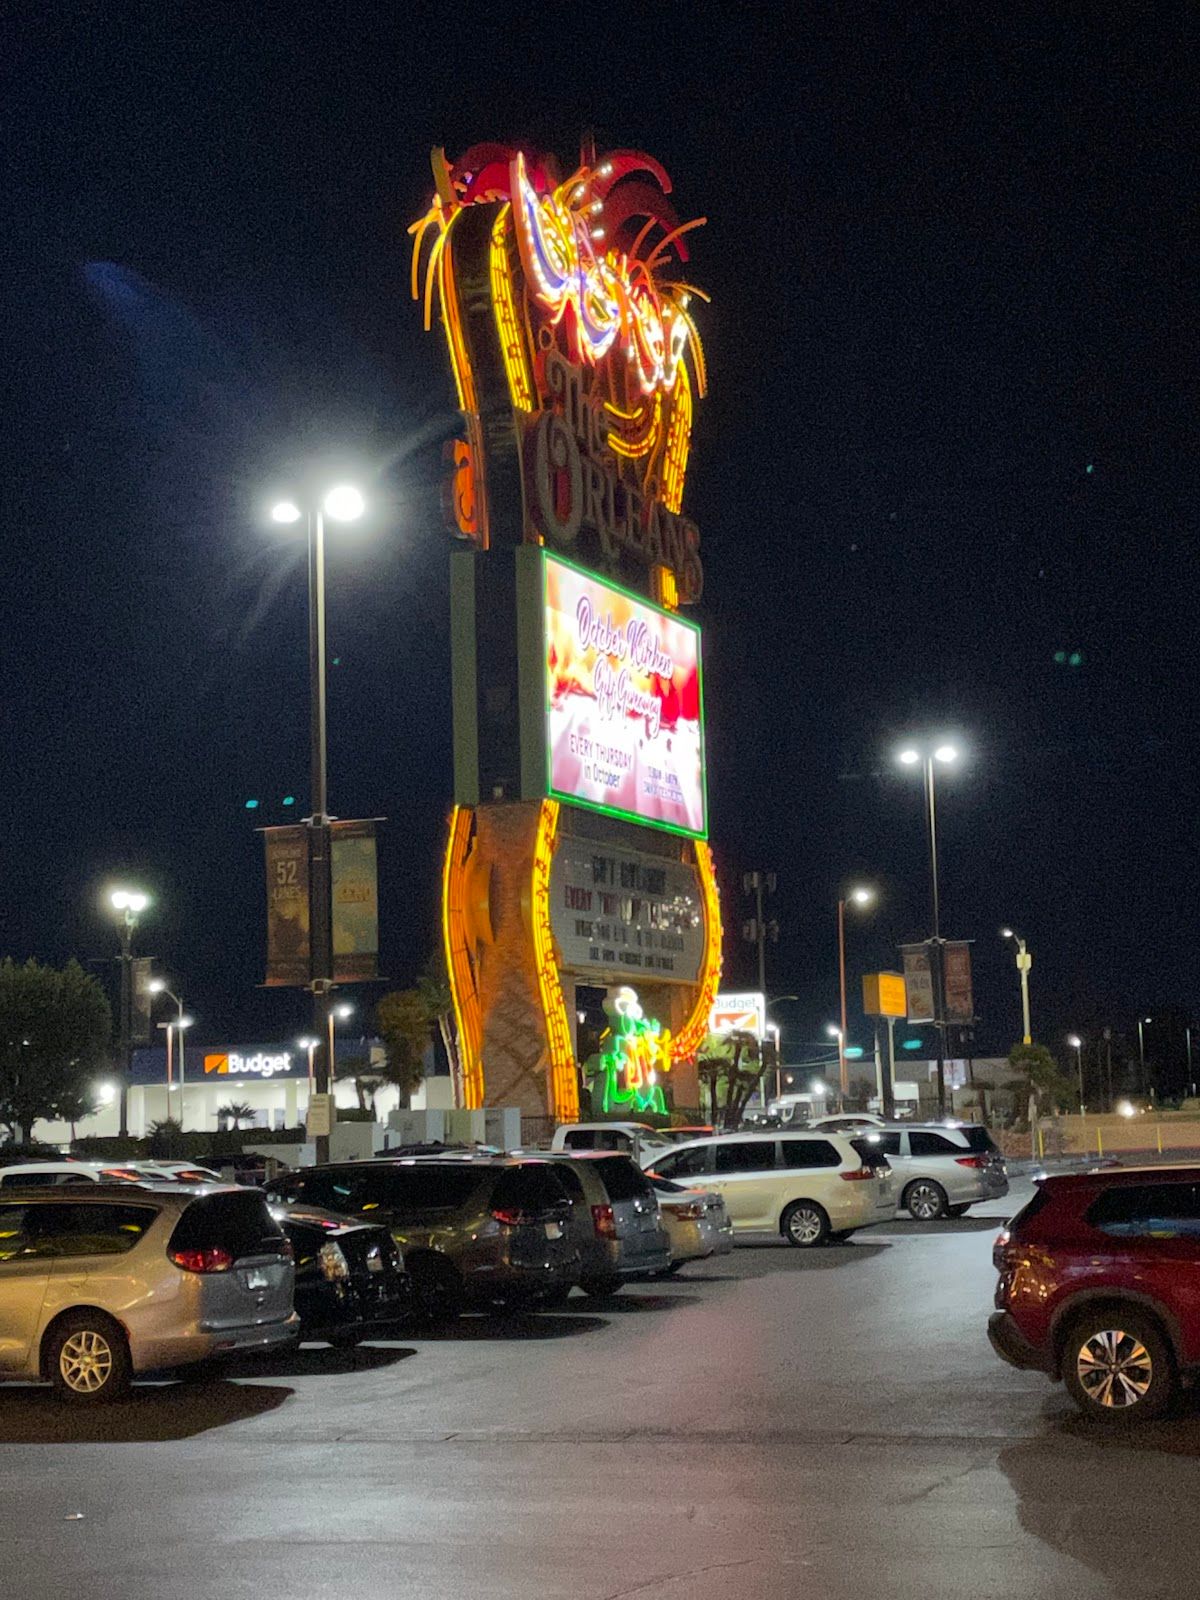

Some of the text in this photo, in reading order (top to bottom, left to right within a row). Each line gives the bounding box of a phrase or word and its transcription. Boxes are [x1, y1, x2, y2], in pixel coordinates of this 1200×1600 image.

[576, 596, 672, 679] October Kitchen
[594, 658, 661, 739] Gift Giveaway
[569, 733, 632, 770] EVERY THURSDAY
[584, 758, 592, 781] in
[592, 761, 622, 787] October
[276, 861, 298, 885] 52
[227, 1051, 291, 1077] Budget
